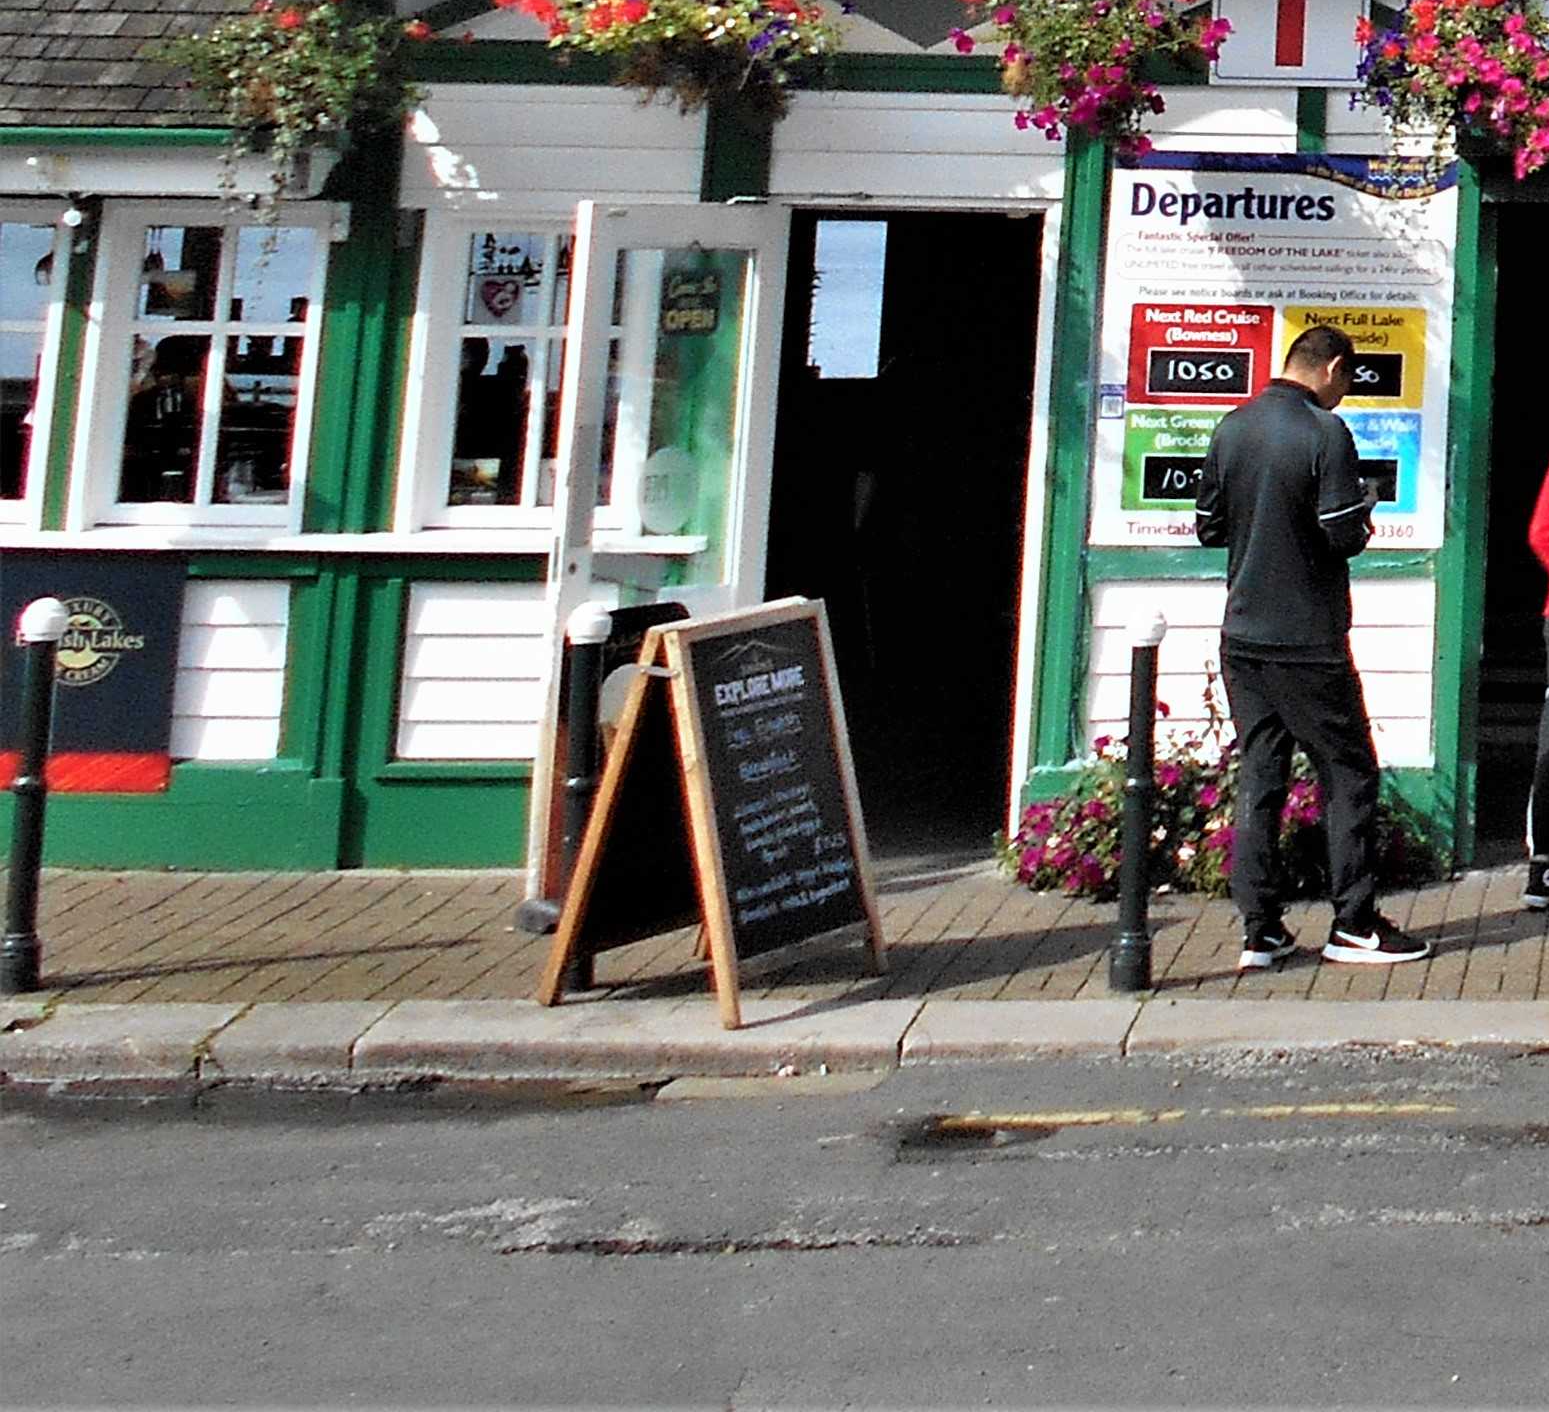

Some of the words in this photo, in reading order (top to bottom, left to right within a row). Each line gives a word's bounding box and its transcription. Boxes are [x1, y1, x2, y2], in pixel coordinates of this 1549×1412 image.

[1131, 182, 1335, 226] Departures
[1286, 247, 1308, 257] THE
[1139, 286, 1169, 296] Please
[1190, 287, 1218, 297] notice
[1221, 287, 1252, 298] boards
[1255, 290, 1265, 298] or
[1268, 288, 1284, 299] ask
[1286, 289, 1296, 299] at
[1300, 289, 1337, 301] Booking
[1340, 289, 1367, 300] Office
[1369, 289, 1383, 300] for
[1145, 309, 1182, 323] Next
[1184, 310, 1212, 323] Red
[1214, 310, 1260, 324] Cruise
[1305, 313, 1339, 326] Next
[1343, 313, 1368, 326] Full
[1372, 314, 1404, 327] Lake
[1165, 327, 1238, 345] (Bowness)
[1168, 359, 1234, 381] 1050
[1131, 414, 1168, 429] Next
[1170, 415, 1215, 429] Green
[1127, 521, 1197, 536] Time-tabl
[1379, 525, 1415, 538] 3360
[92, 629, 144, 649] Lakes
